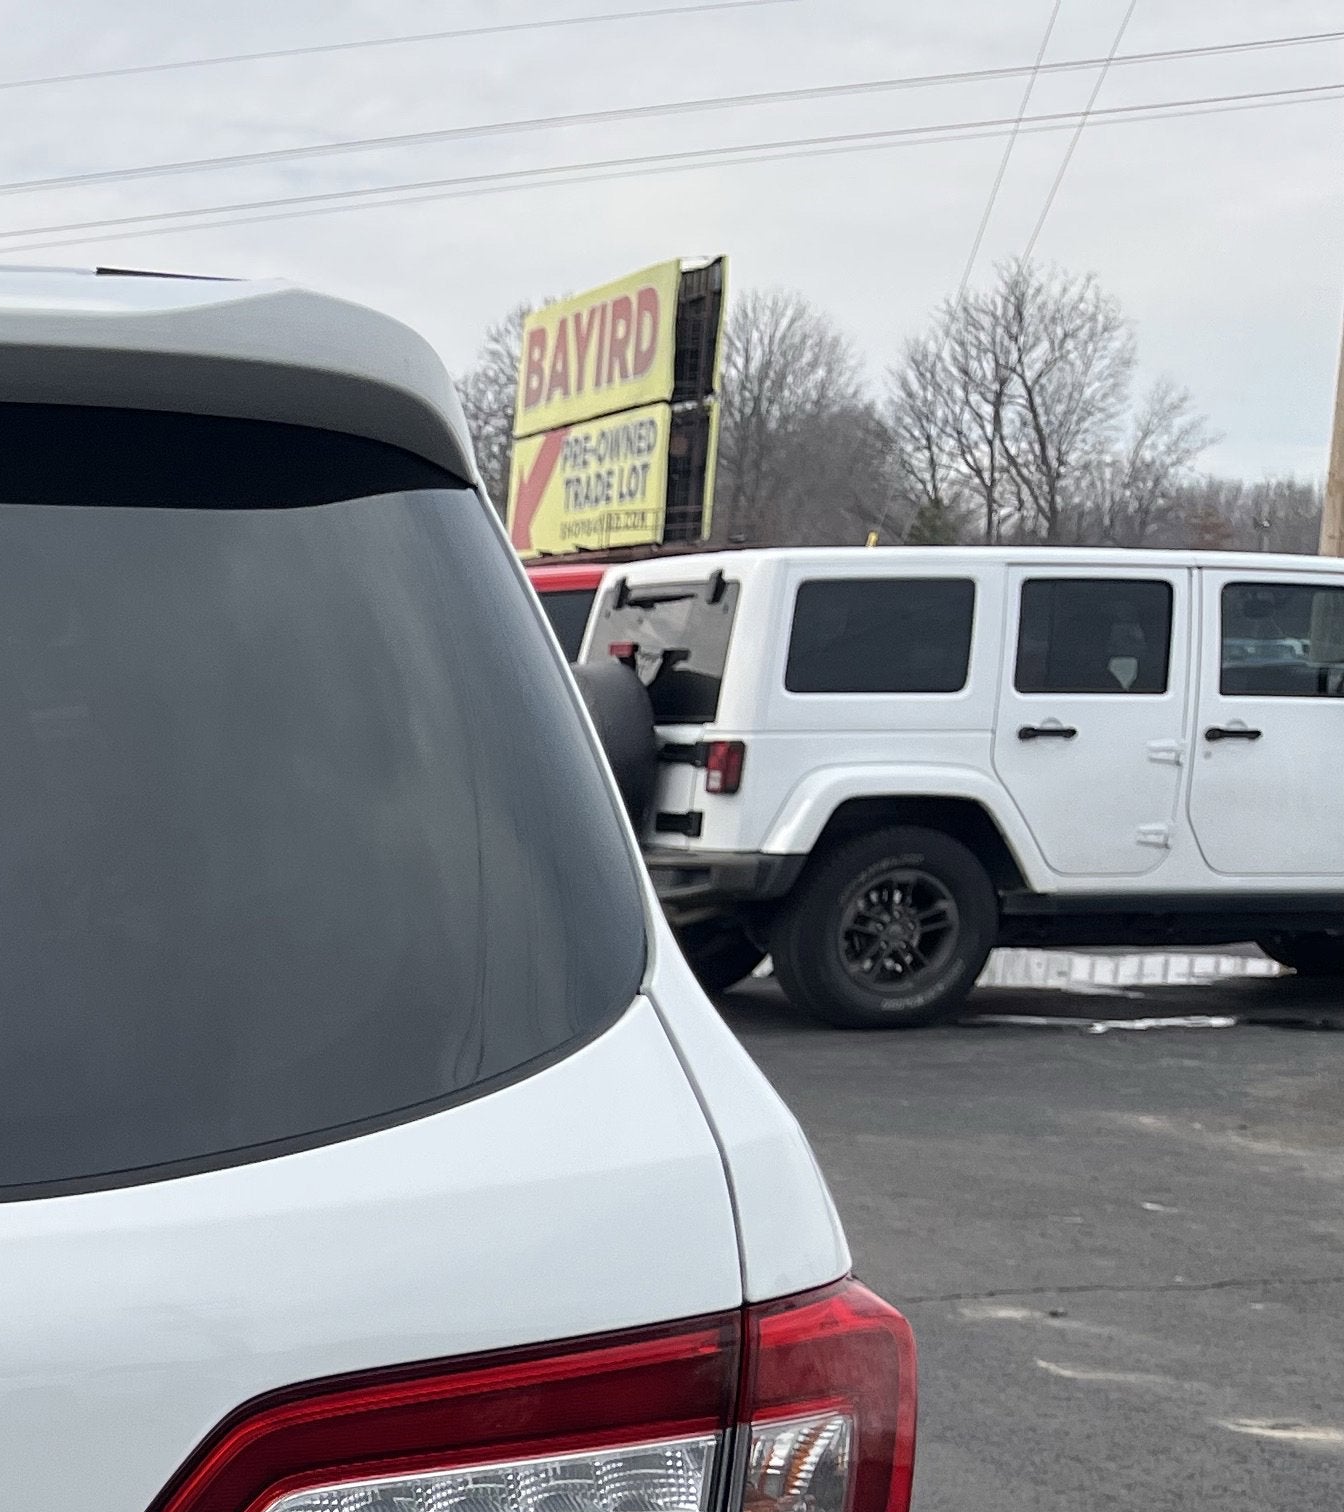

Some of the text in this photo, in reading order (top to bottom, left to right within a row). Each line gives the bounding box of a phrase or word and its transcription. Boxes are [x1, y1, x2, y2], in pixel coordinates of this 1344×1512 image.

[522, 286, 659, 411] BAYIRD
[562, 417, 658, 472] PRE-OWNED
[564, 462, 650, 512] TRADE LOT
